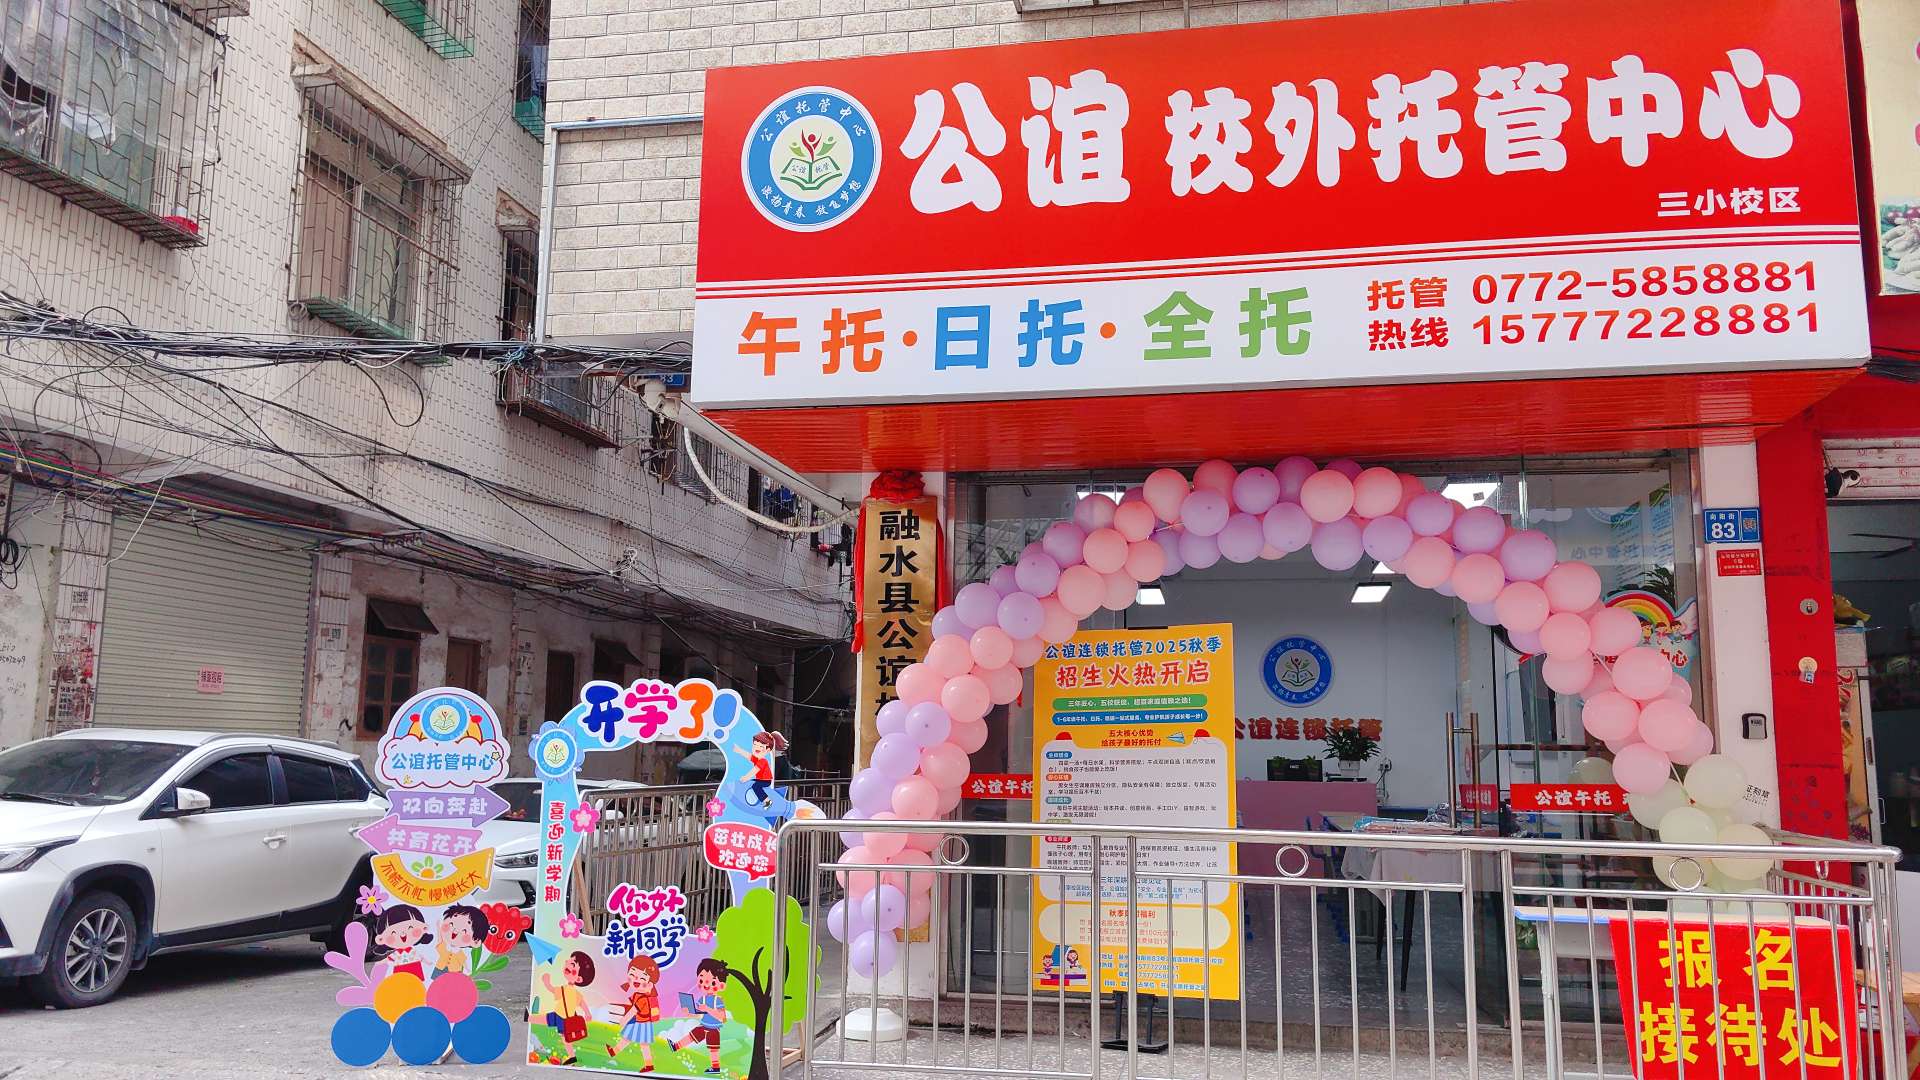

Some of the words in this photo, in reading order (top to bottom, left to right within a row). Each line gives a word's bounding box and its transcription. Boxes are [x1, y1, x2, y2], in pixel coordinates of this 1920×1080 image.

[760, 97, 867, 142] 公谊托管中心
[900, 69, 1130, 214] 公谊
[1164, 48, 1801, 198] 校外托管中心
[1656, 186, 1801, 217] 三小校区
[1367, 276, 1448, 312] 托管
[1471, 260, 1817, 305] 0772-5858881
[1367, 317, 1449, 352] 热线
[1472, 302, 1819, 346] 15777228881
[1711, 521, 1736, 539] 83
[1045, 635, 1222, 659] 公谊连锁托管2025秋季
[1056, 659, 1211, 689] 招生火热开启
[390, 751, 495, 771] 公谊托管中心
[402, 796, 488, 816] 双向奔赴
[1535, 789, 1612, 806] 公谊午托
[386, 827, 474, 855] 共育花开
[544, 801, 566, 903] 喜迎新学期
[713, 828, 777, 854] 茁壮成长
[718, 848, 769, 873] 欢迎您
[380, 859, 426, 900] 不慌不忙
[428, 870, 482, 901] 慢慢长大
[609, 885, 687, 926] 你好
[1109, 908, 1156, 919] 秋季福利
[604, 917, 686, 968] 新同学
[1659, 928, 1796, 991] 报名
[1639, 1001, 1841, 1067] 接待处
